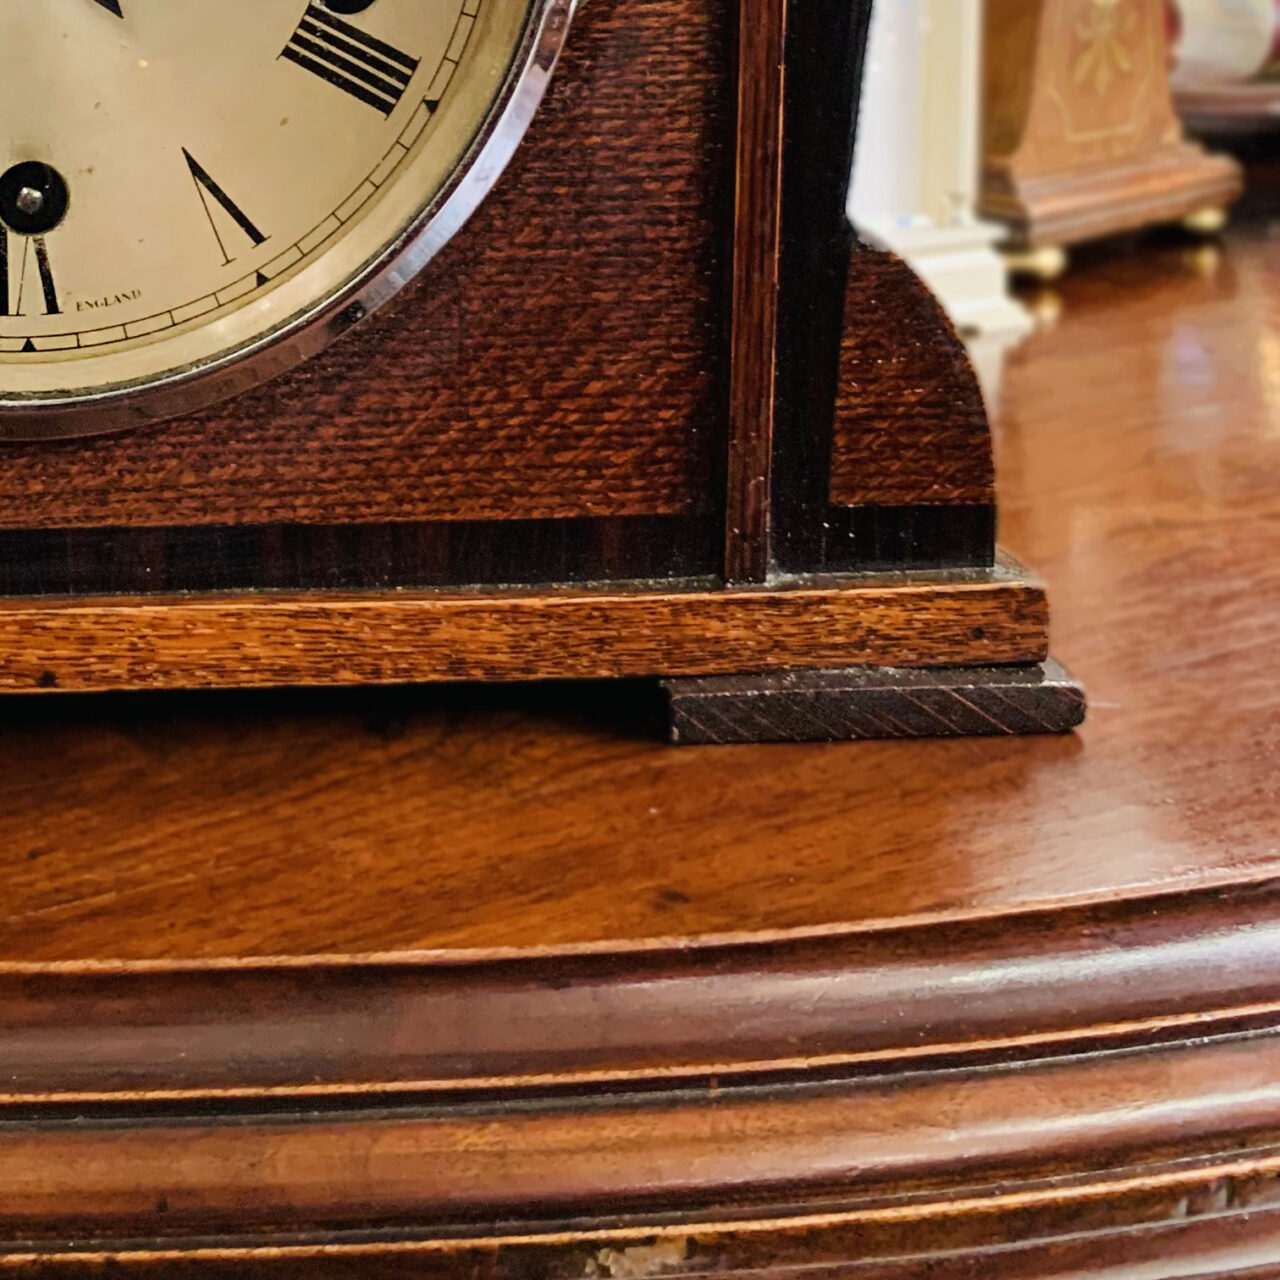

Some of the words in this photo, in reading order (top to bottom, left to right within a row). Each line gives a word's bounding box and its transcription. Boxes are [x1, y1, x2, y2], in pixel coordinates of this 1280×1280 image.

[276, 0, 422, 121] IIII
[181, 147, 272, 266] V
[76, 288, 142, 311] ENGLAND
